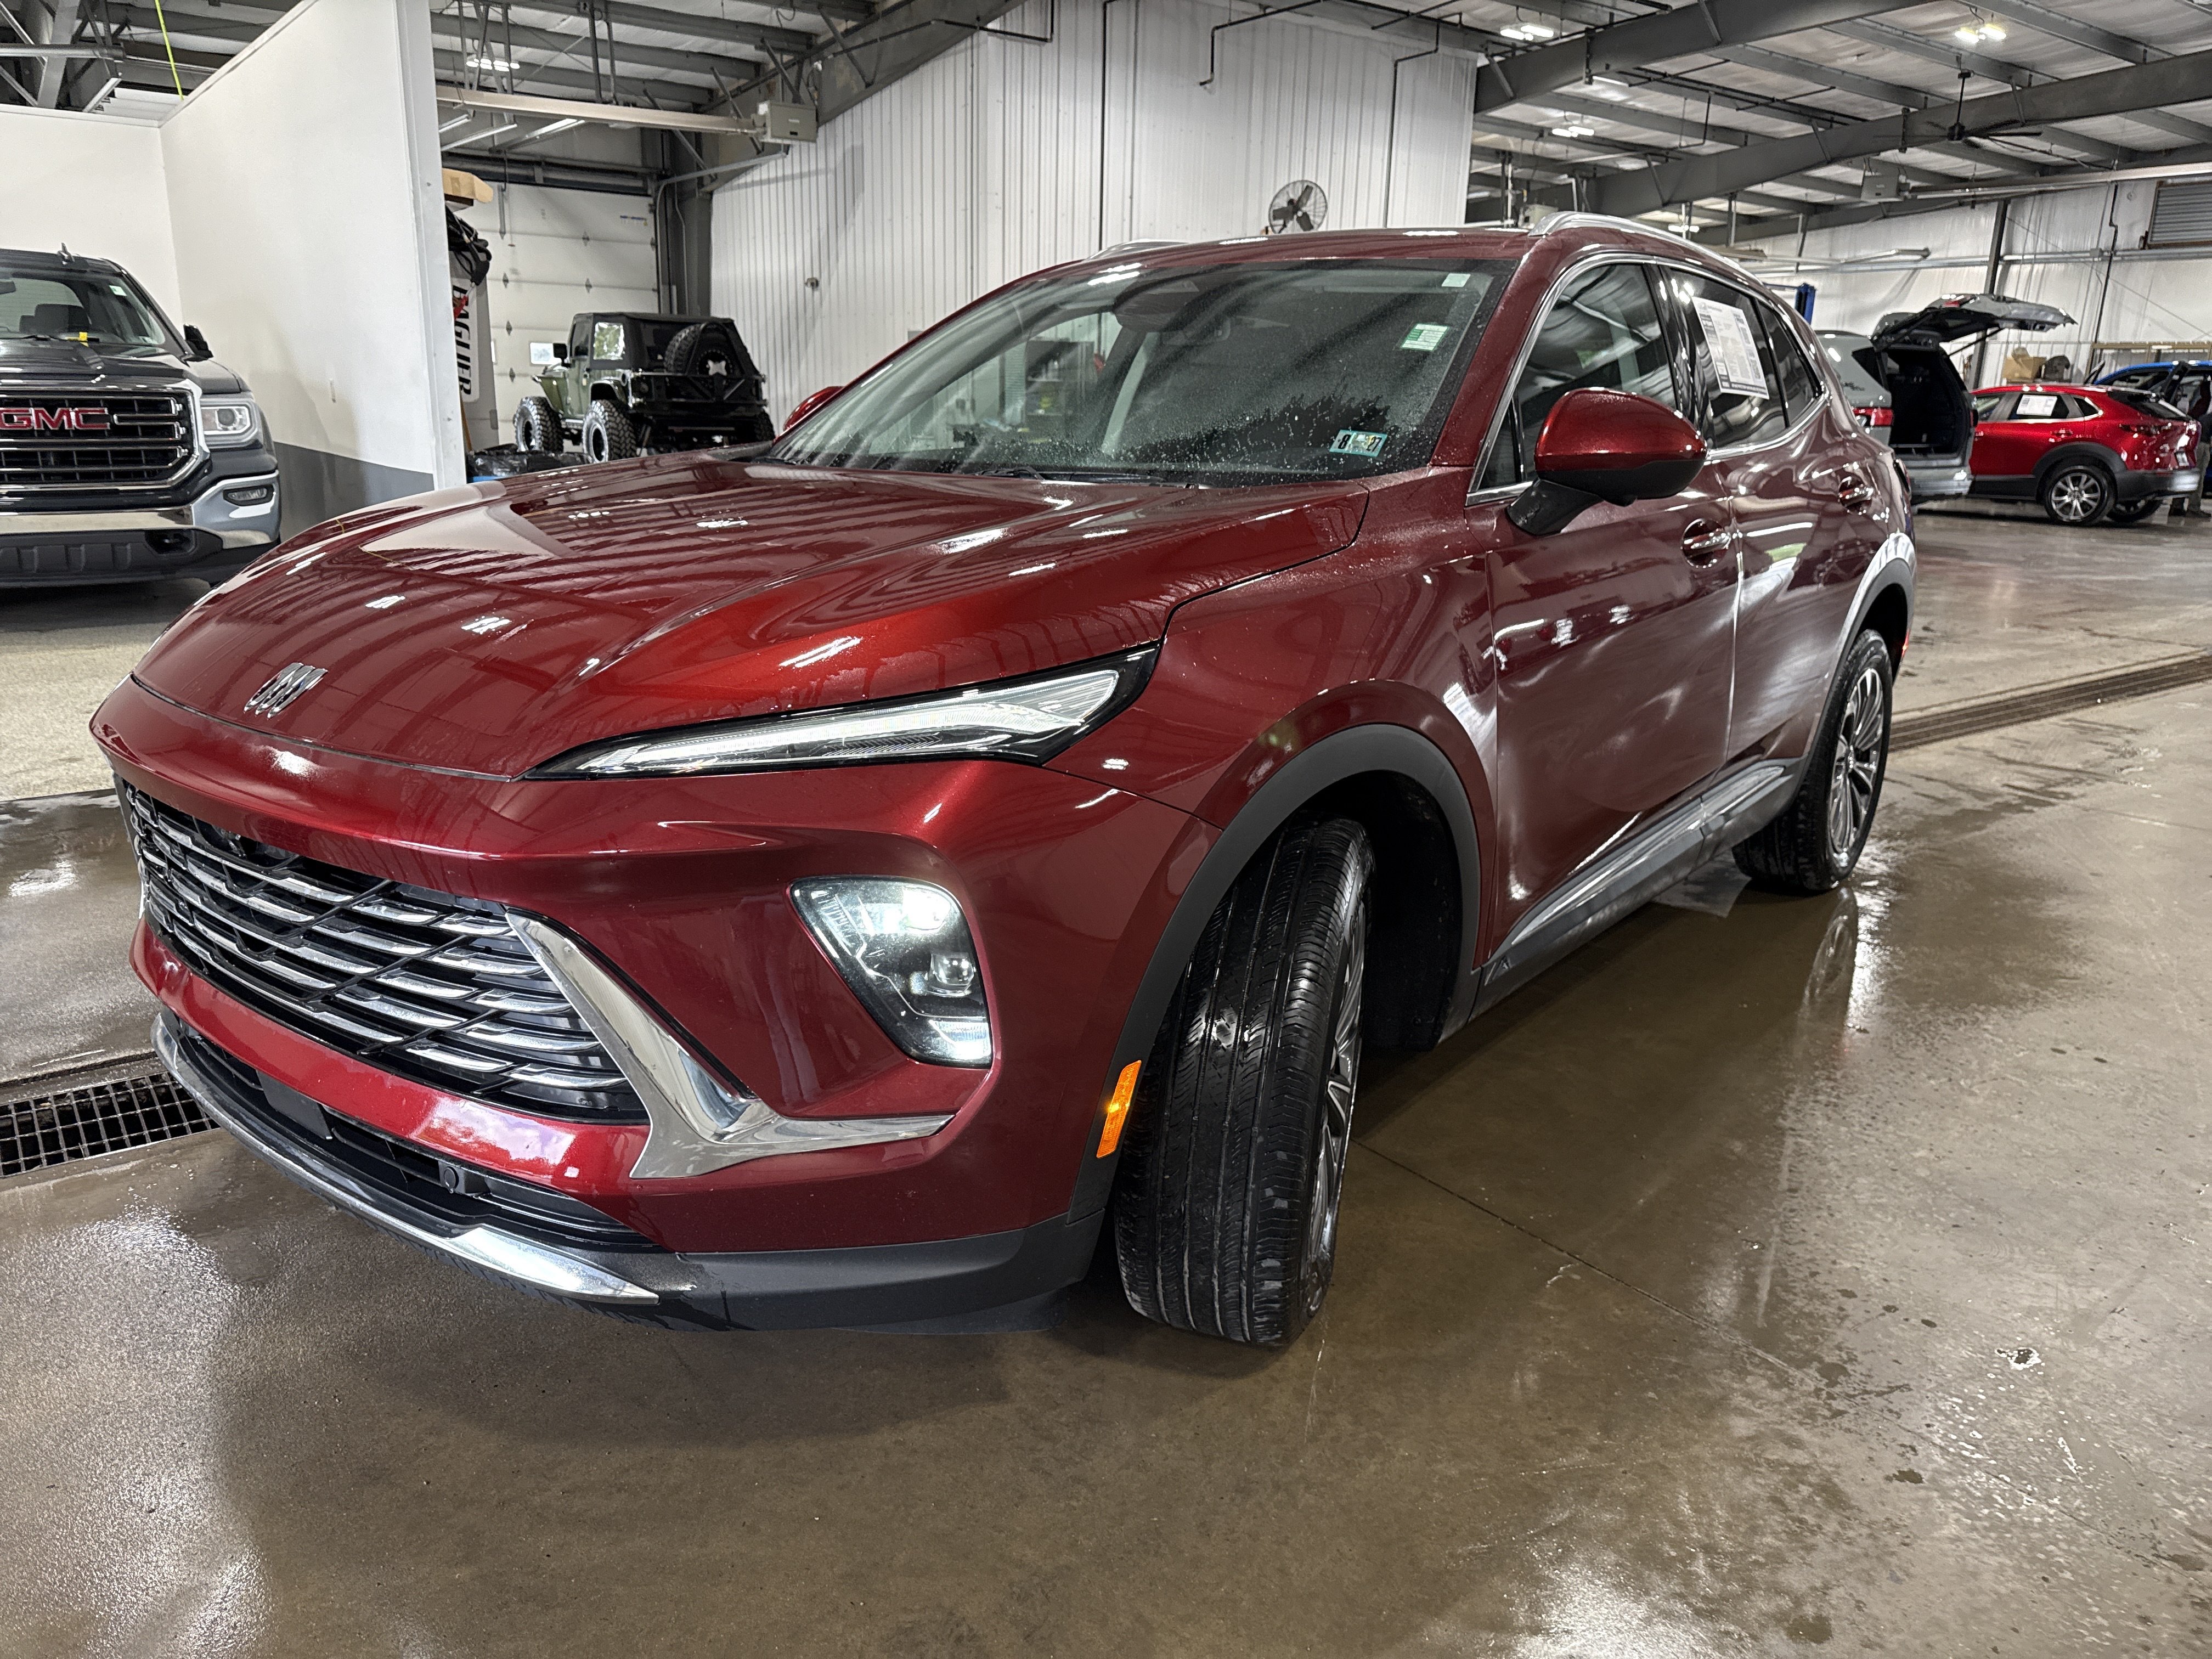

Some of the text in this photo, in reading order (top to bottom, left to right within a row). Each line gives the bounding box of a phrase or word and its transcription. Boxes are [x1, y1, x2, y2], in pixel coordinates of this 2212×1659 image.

[0, 407, 110, 430] GMC
[1338, 434, 1383, 452] 8 27
